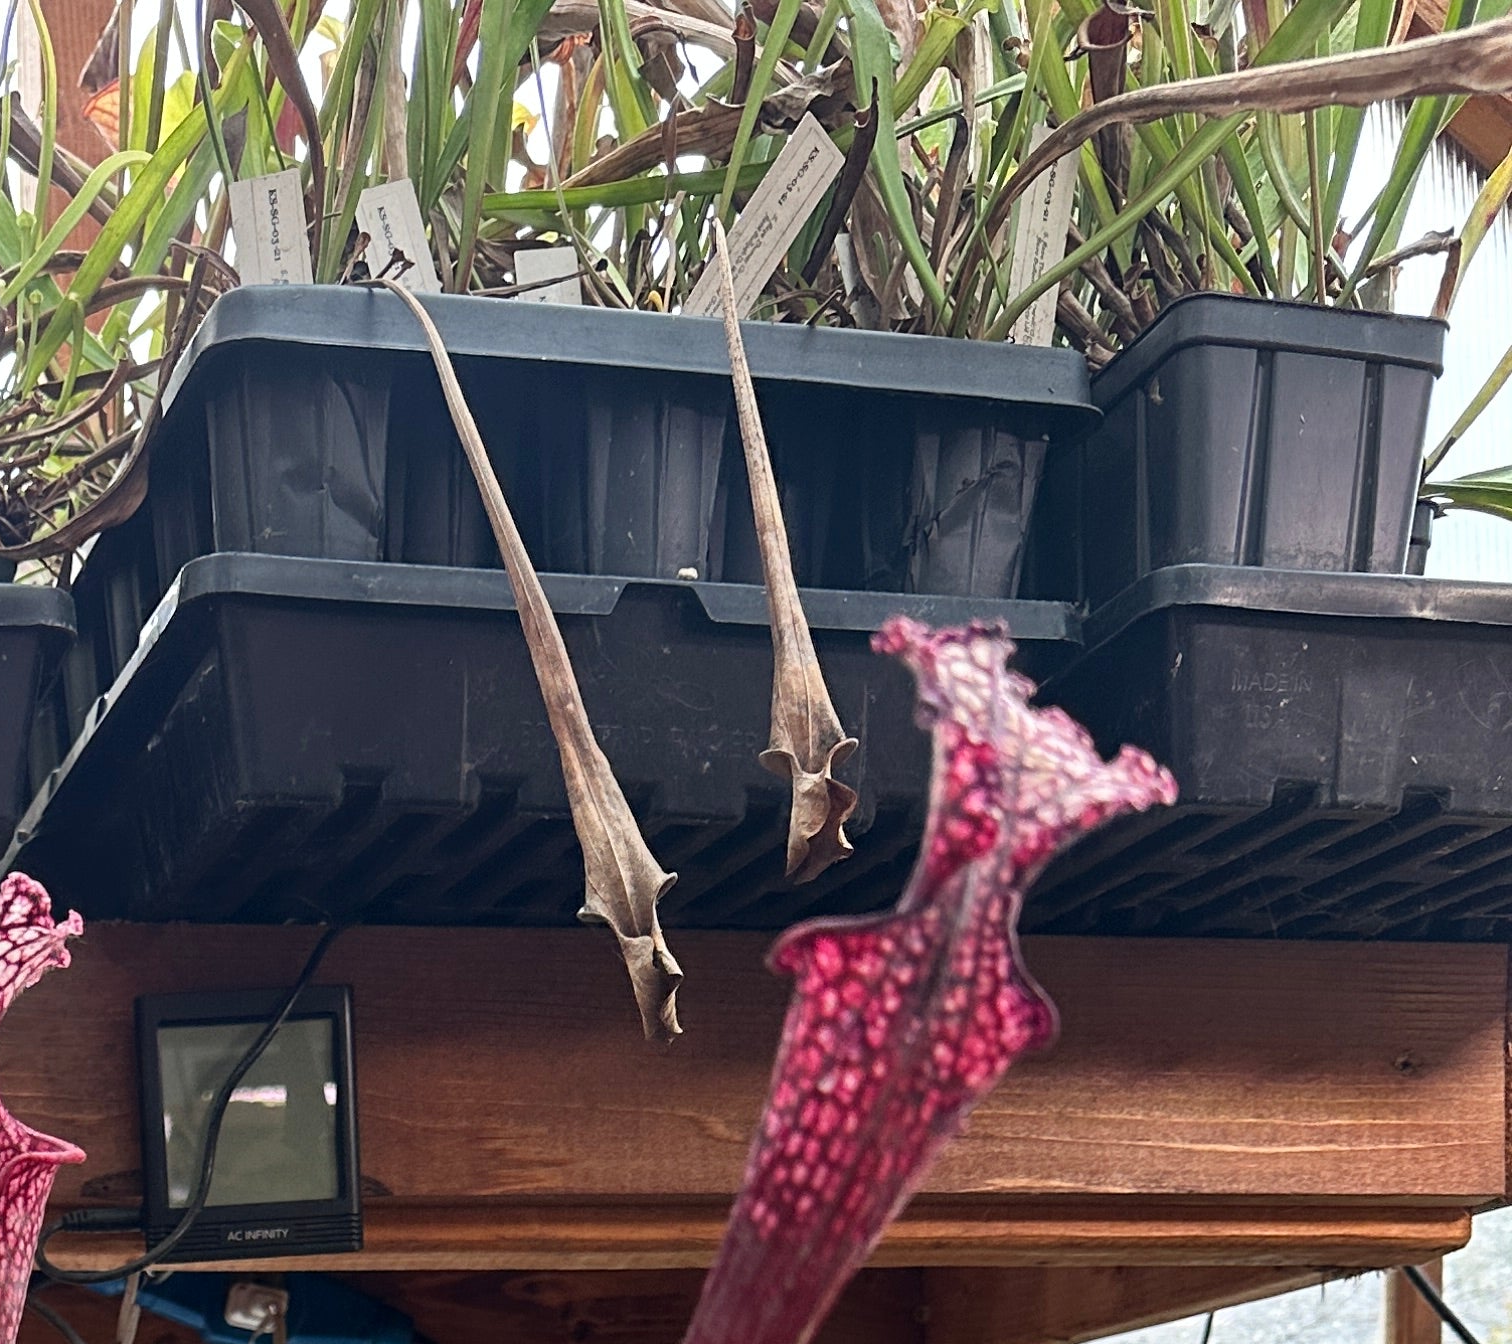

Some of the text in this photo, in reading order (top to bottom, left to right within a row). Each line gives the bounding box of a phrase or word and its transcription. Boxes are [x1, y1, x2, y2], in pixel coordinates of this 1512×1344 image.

[1231, 667, 1289, 692] MADE
[227, 1229, 289, 1241] AC INFINITY
